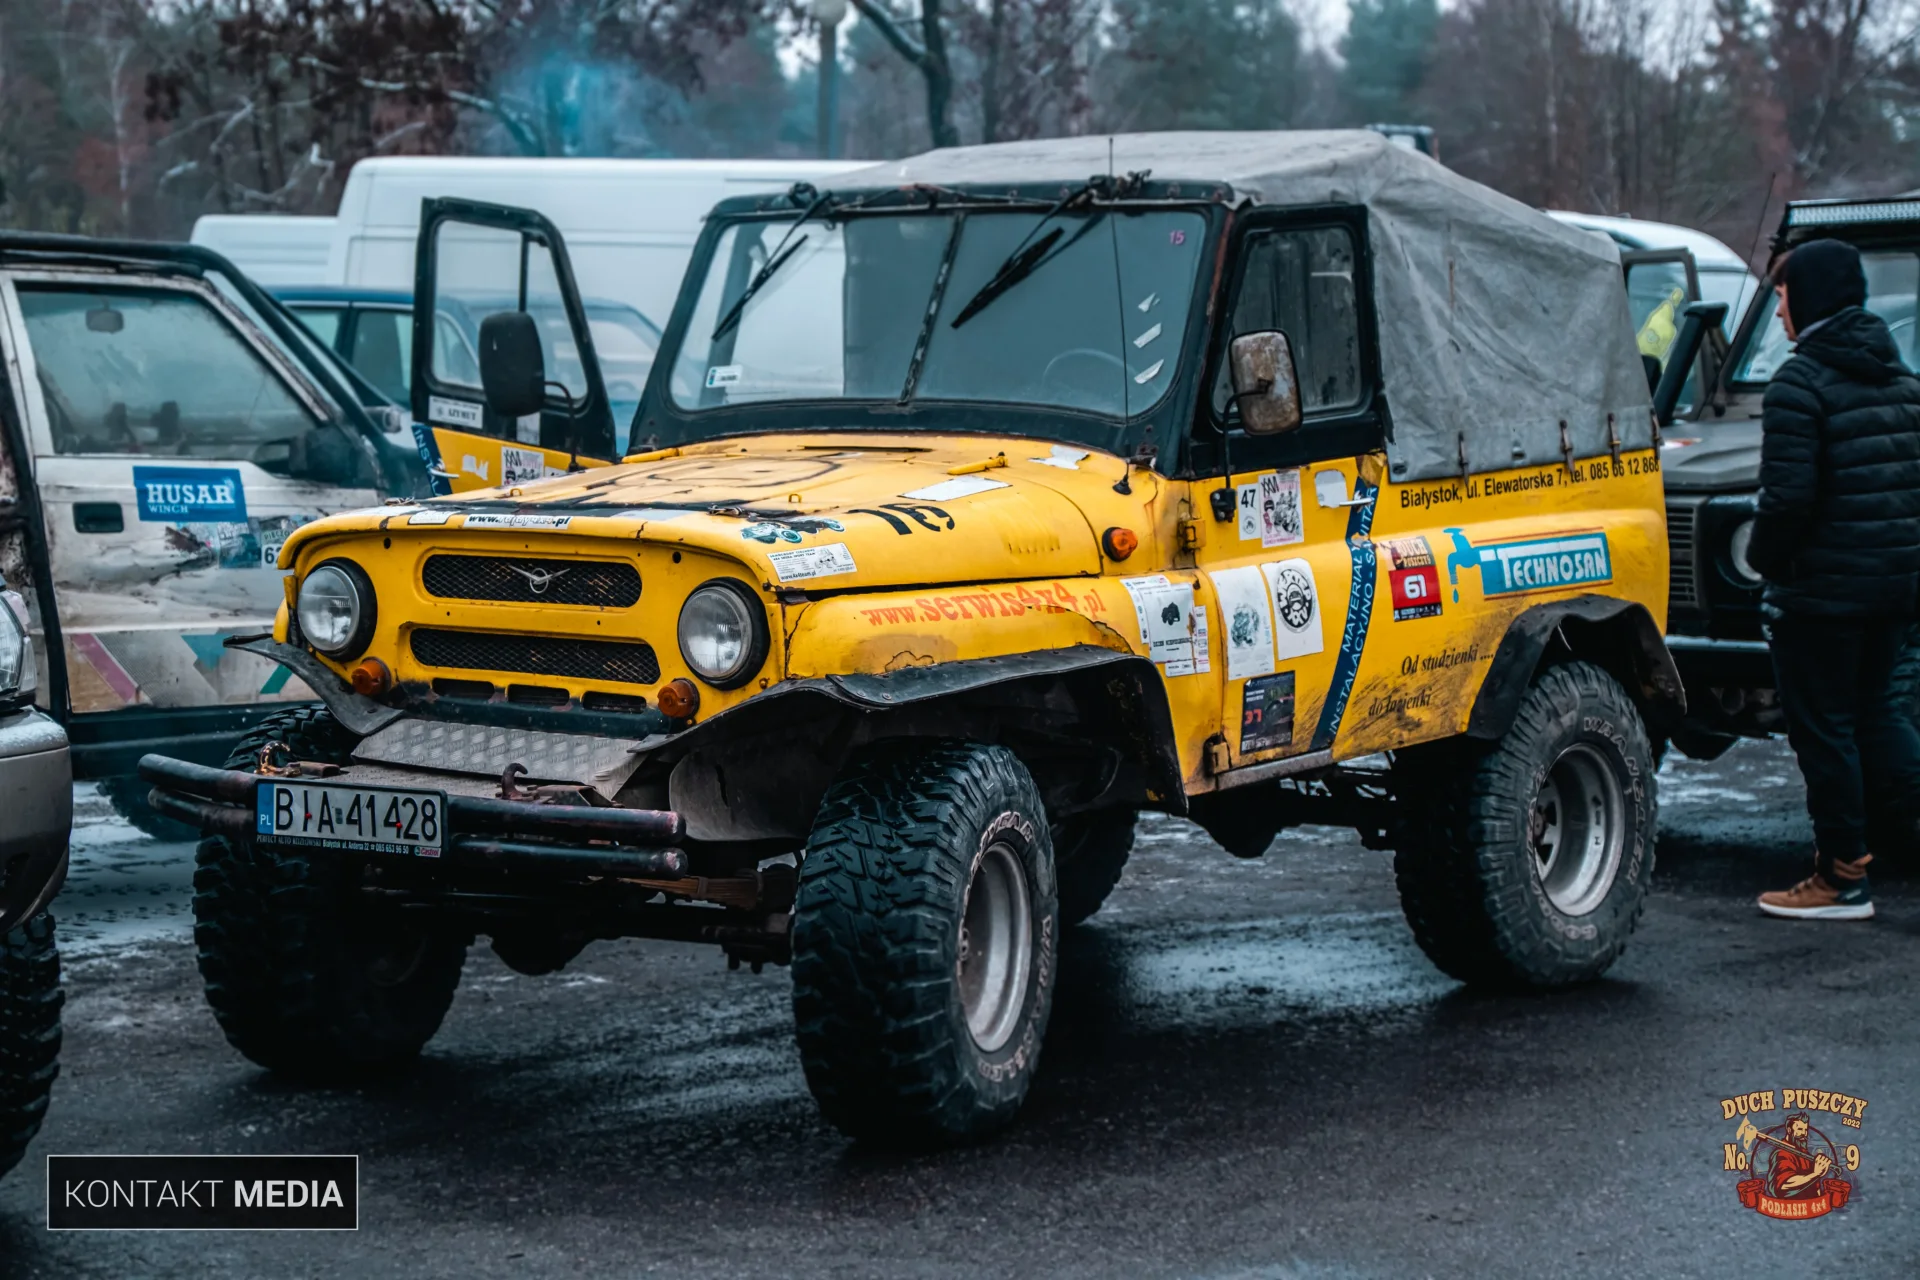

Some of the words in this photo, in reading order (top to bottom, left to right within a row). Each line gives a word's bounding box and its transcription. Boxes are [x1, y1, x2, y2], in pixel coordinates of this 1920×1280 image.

[413, 429, 444, 496] INSTAL
[146, 483, 234, 504] HUSAR
[1401, 481, 1462, 510] Białystok,
[1466, 480, 1481, 499] ul.
[1484, 471, 1554, 497] Elewatorska
[1556, 468, 1567, 488] 7,
[1570, 466, 1587, 483] tel.
[1590, 462, 1609, 481] 085
[1628, 458, 1640, 475] 12
[1642, 455, 1660, 473] 868
[149, 505, 189, 513] WINCH
[1241, 489, 1256, 508] 47
[1496, 537, 1608, 589] TECHNOSAN
[1404, 574, 1427, 599] 61
[860, 582, 1106, 626] www.serwis4x4.pl
[1329, 583, 1374, 735] INSTALACYJNO
[1402, 655, 1420, 676] Od
[1422, 643, 1479, 671] studzienki
[1369, 697, 1383, 716] do
[260, 814, 272, 826] PL
